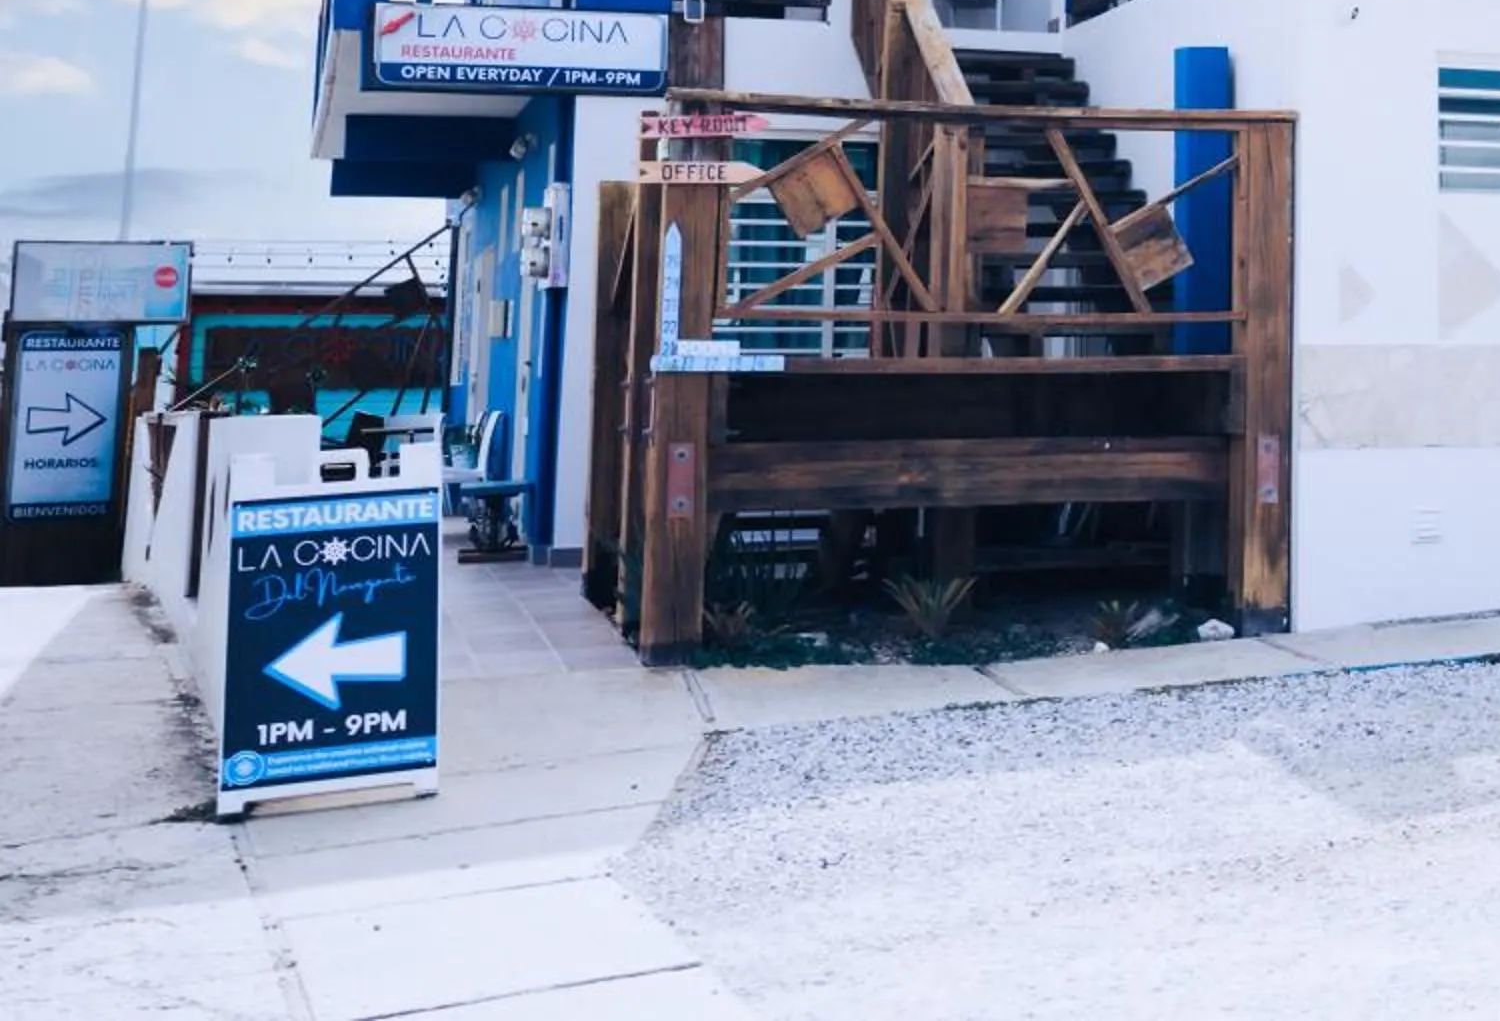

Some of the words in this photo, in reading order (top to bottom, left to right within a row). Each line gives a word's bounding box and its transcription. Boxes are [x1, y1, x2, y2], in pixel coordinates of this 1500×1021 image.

[417, 14, 465, 39] LA
[401, 44, 517, 60] RESTAURANTE
[401, 65, 450, 80] OPEN
[456, 67, 543, 83] EVERYDAY
[661, 164, 728, 180] OFFICE
[25, 337, 121, 348] RESTAURANTE
[25, 359, 48, 372] LA
[13, 504, 107, 518] BIENVENIDOS
[237, 498, 433, 532] RESTAURANTE
[237, 544, 283, 572] LA
[257, 719, 314, 745] 1PM
[345, 709, 407, 736] 9PM
